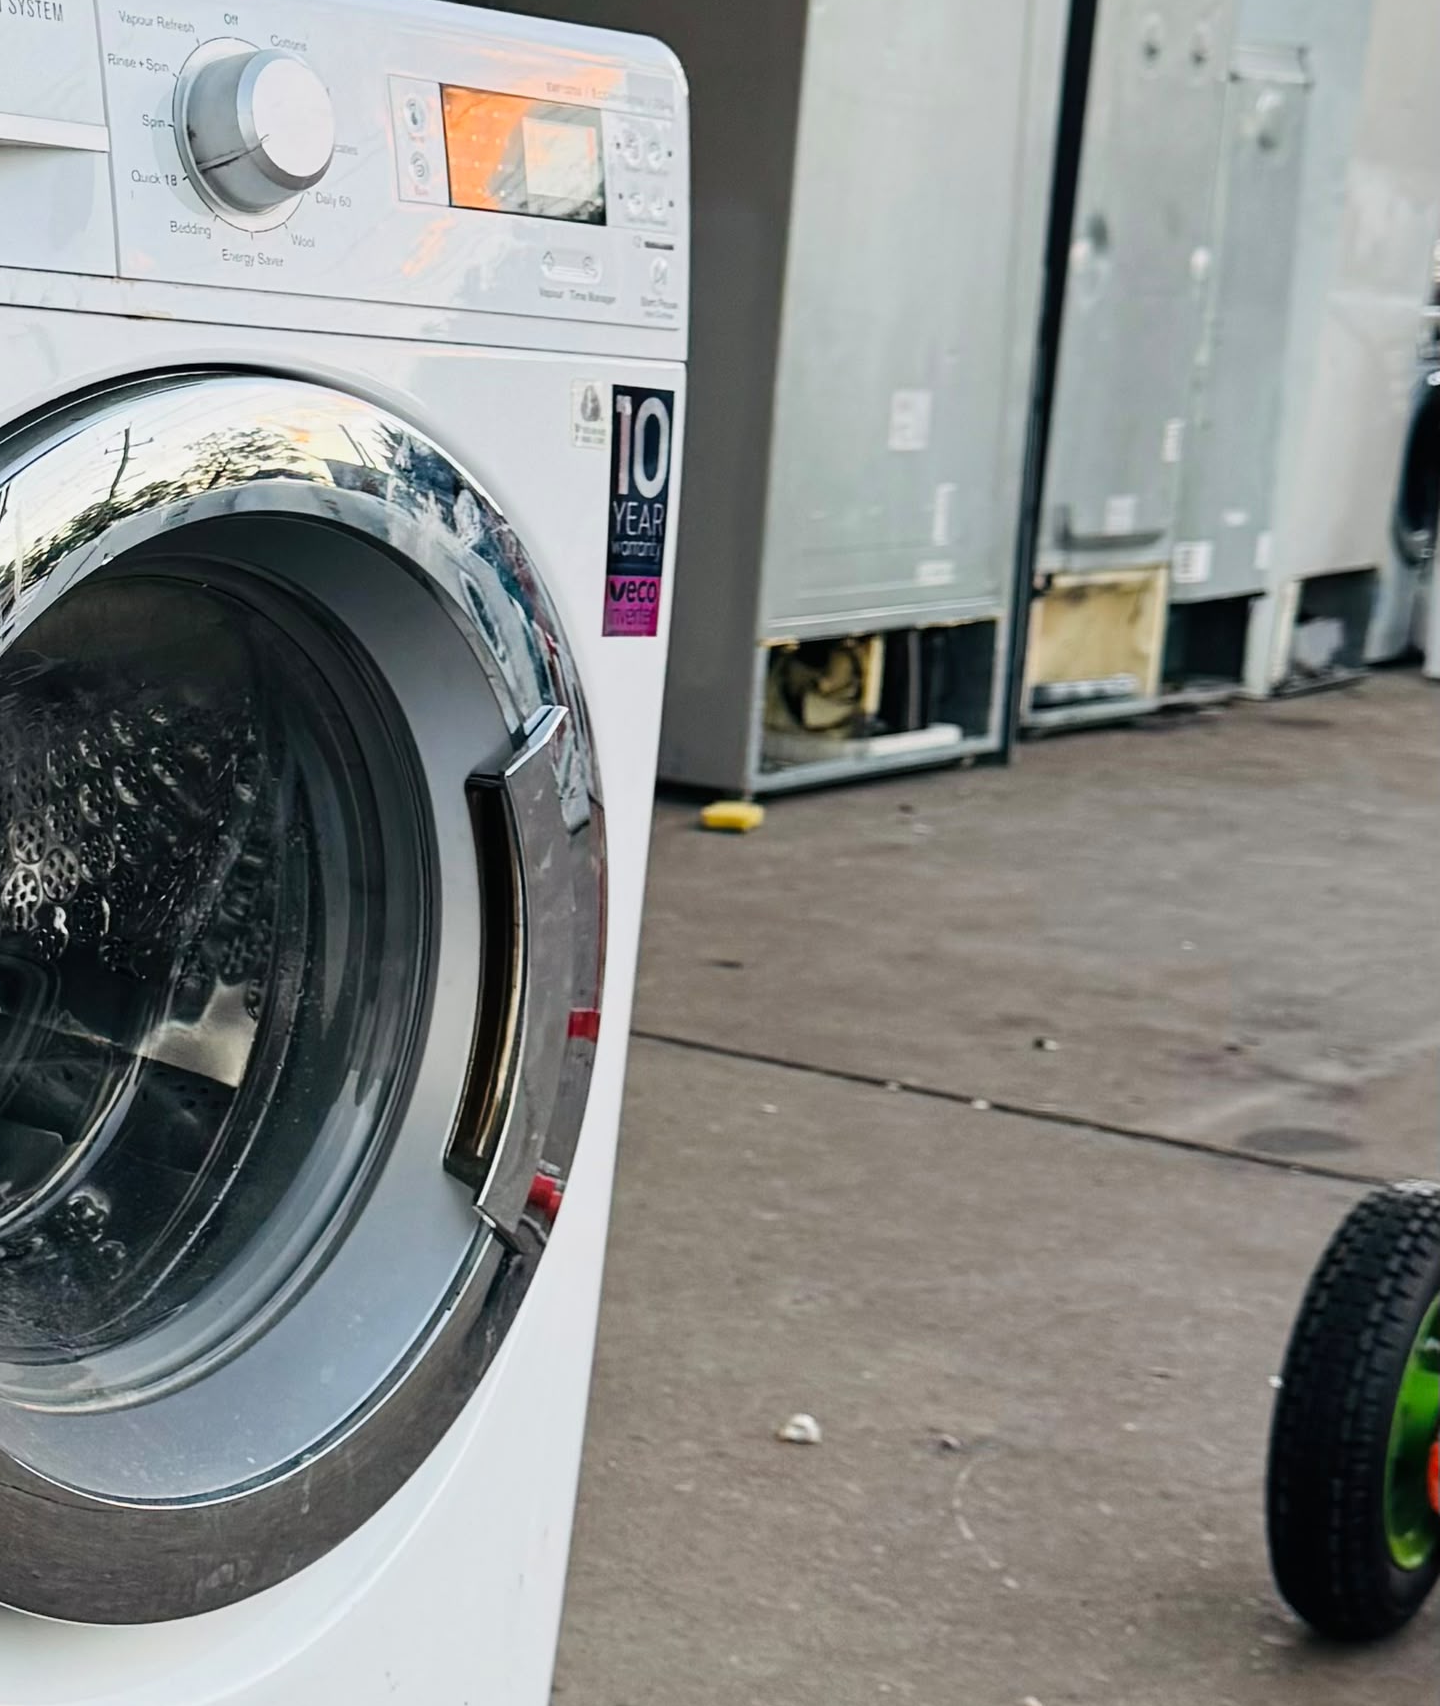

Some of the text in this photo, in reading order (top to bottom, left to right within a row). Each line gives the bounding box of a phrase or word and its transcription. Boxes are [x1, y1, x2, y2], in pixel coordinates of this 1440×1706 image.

[223, 13, 239, 26] Off
[142, 114, 166, 129] Spin
[131, 170, 178, 187] Quick 18
[170, 220, 211, 239] Bedding
[616, 394, 670, 499] 10
[612, 501, 664, 537] YEAR
